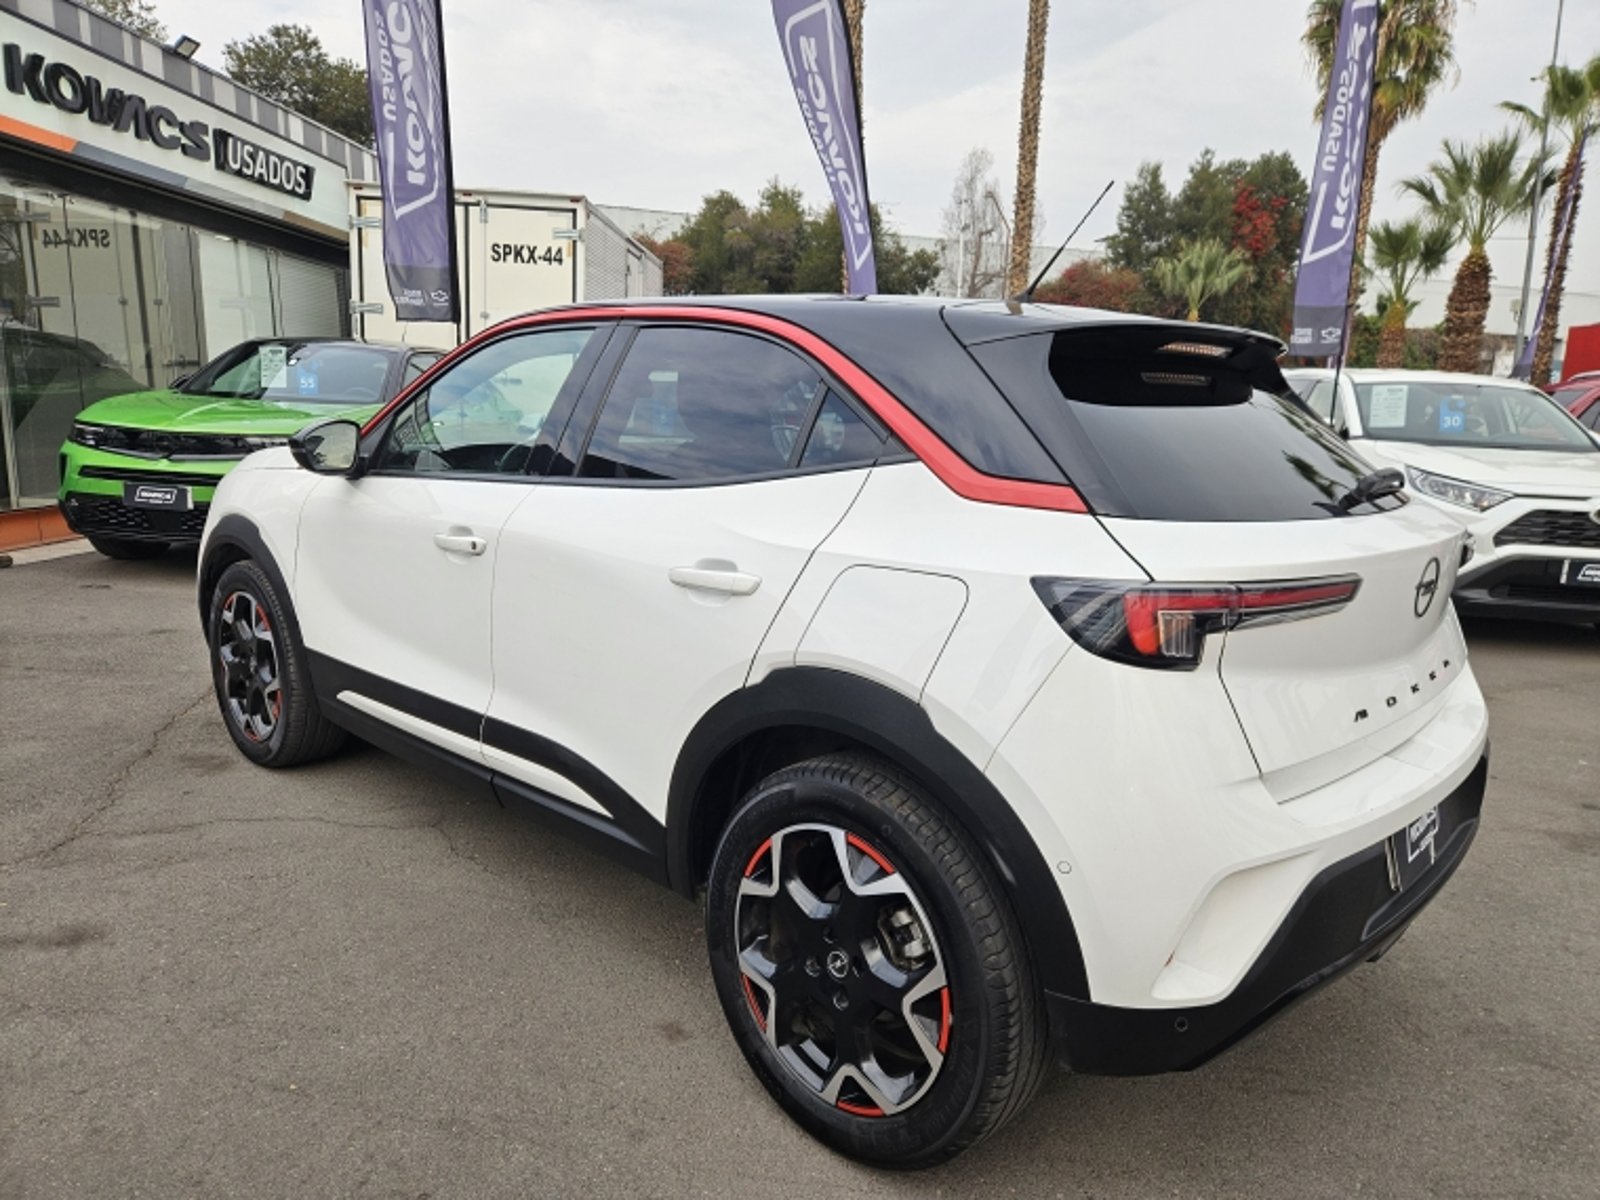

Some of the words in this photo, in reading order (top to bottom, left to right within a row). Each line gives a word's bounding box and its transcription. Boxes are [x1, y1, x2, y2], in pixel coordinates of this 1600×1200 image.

[3, 42, 212, 162] KOVACS
[227, 137, 307, 195] USADOS
[491, 243, 564, 266] SPKX-44
